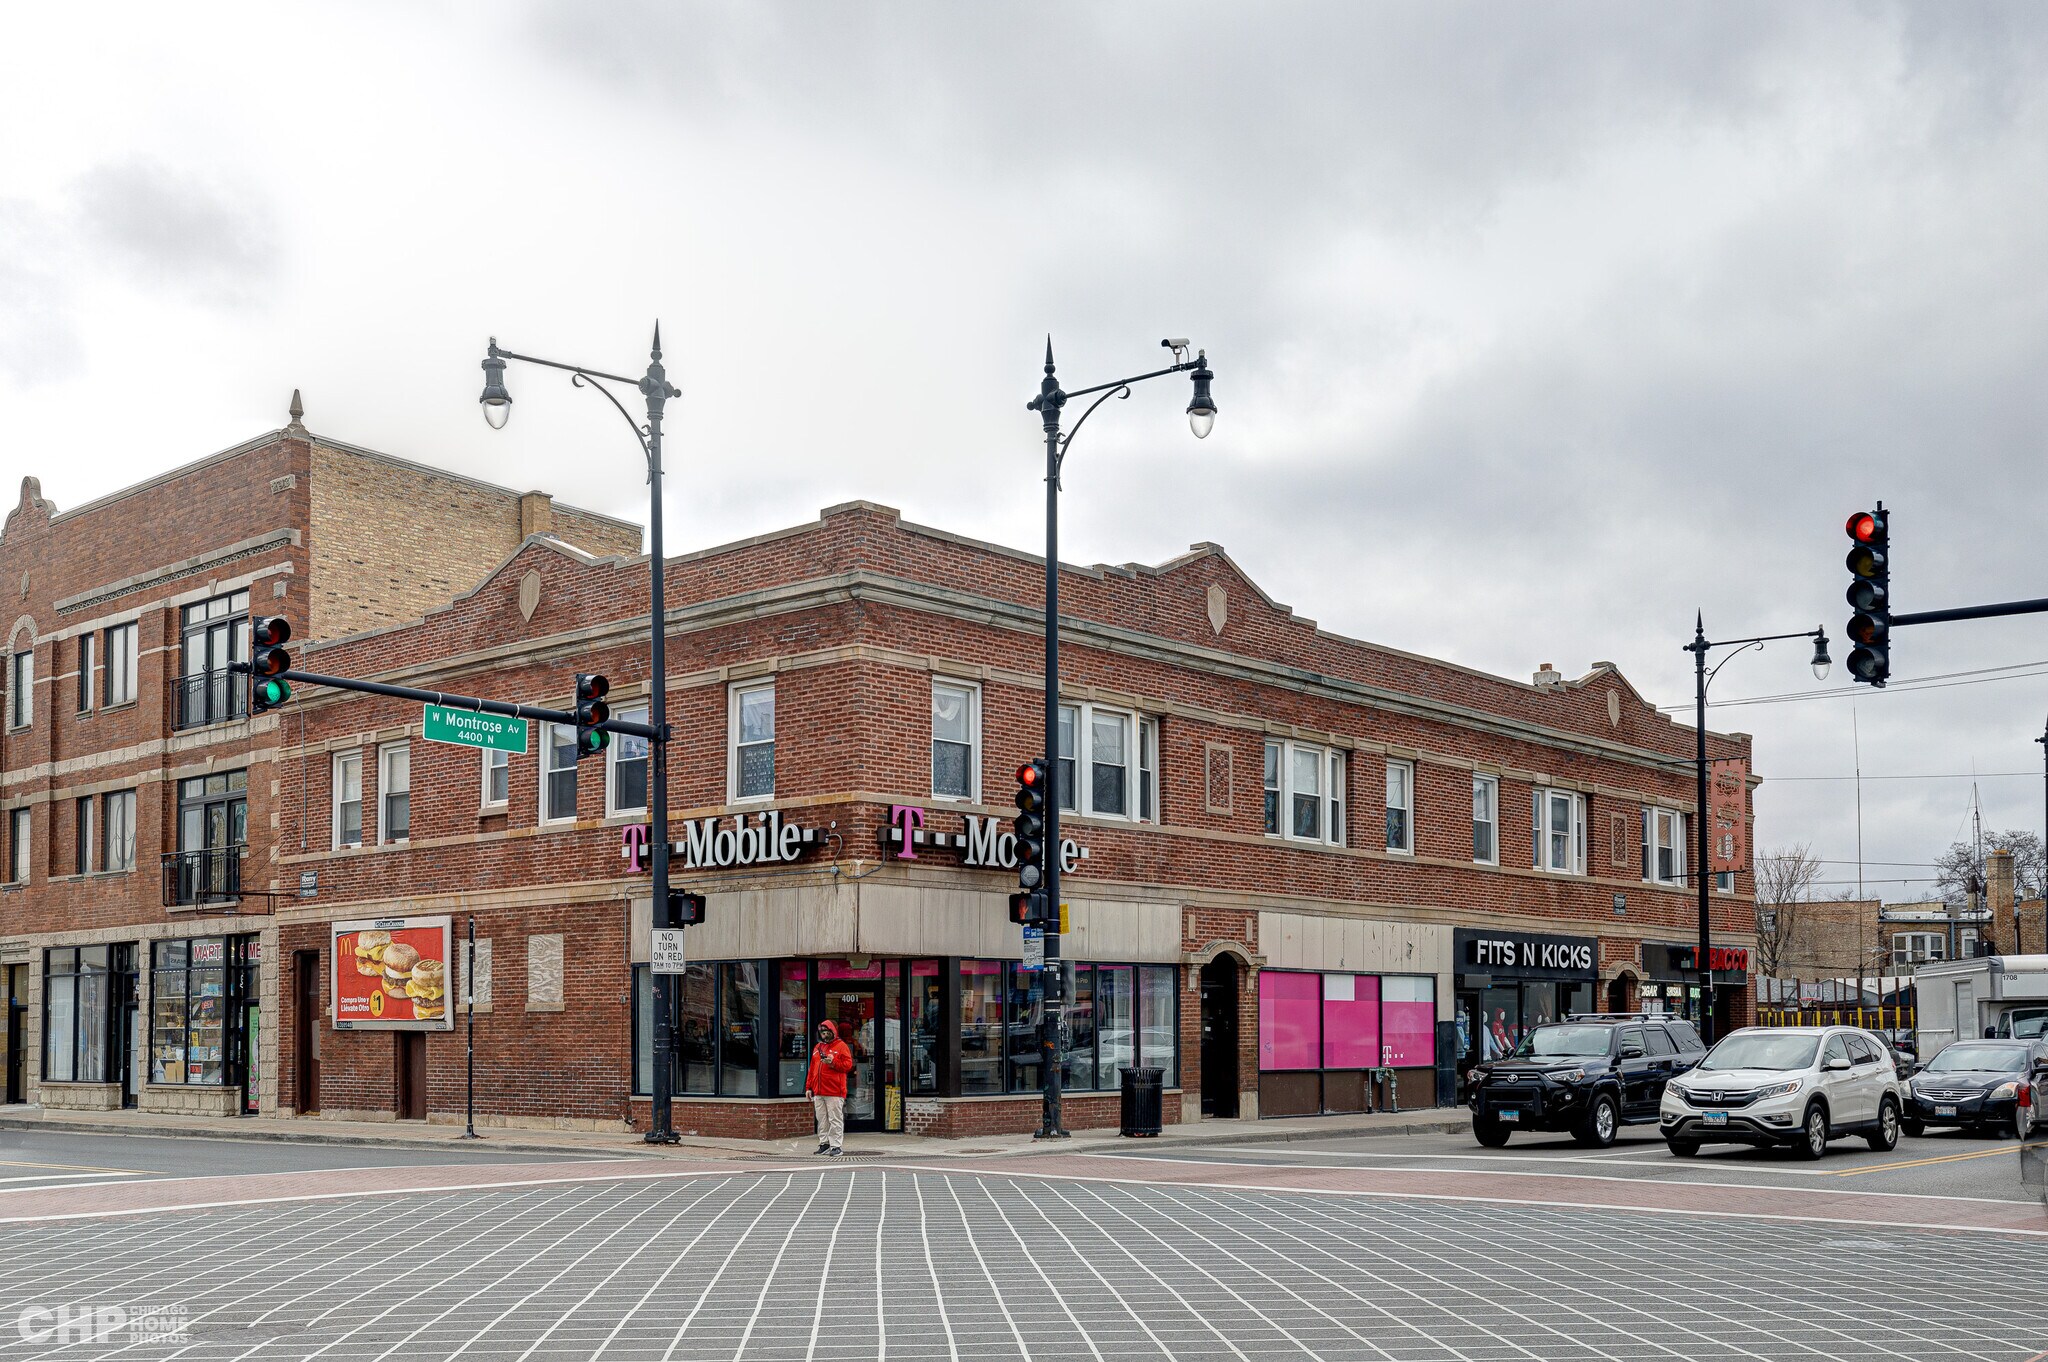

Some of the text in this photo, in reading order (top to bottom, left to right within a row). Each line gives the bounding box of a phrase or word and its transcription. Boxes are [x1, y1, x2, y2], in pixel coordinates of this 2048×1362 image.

[432, 711, 520, 734] W Montrose Av
[457, 730, 494, 745] 4400 N
[683, 810, 801, 869] Mobile
[964, 815, 1078, 874] Moe
[661, 932, 674, 941] NO
[193, 943, 222, 962] MART
[658, 942, 678, 951] TURN
[1477, 939, 1592, 969] FITS N KICKS
[653, 952, 683, 961] ON RED
[653, 961, 664, 969] 7AM
[672, 961, 684, 969] 7PM
[1691, 946, 1748, 971] TBACCO
[841, 994, 859, 1003] 4001
